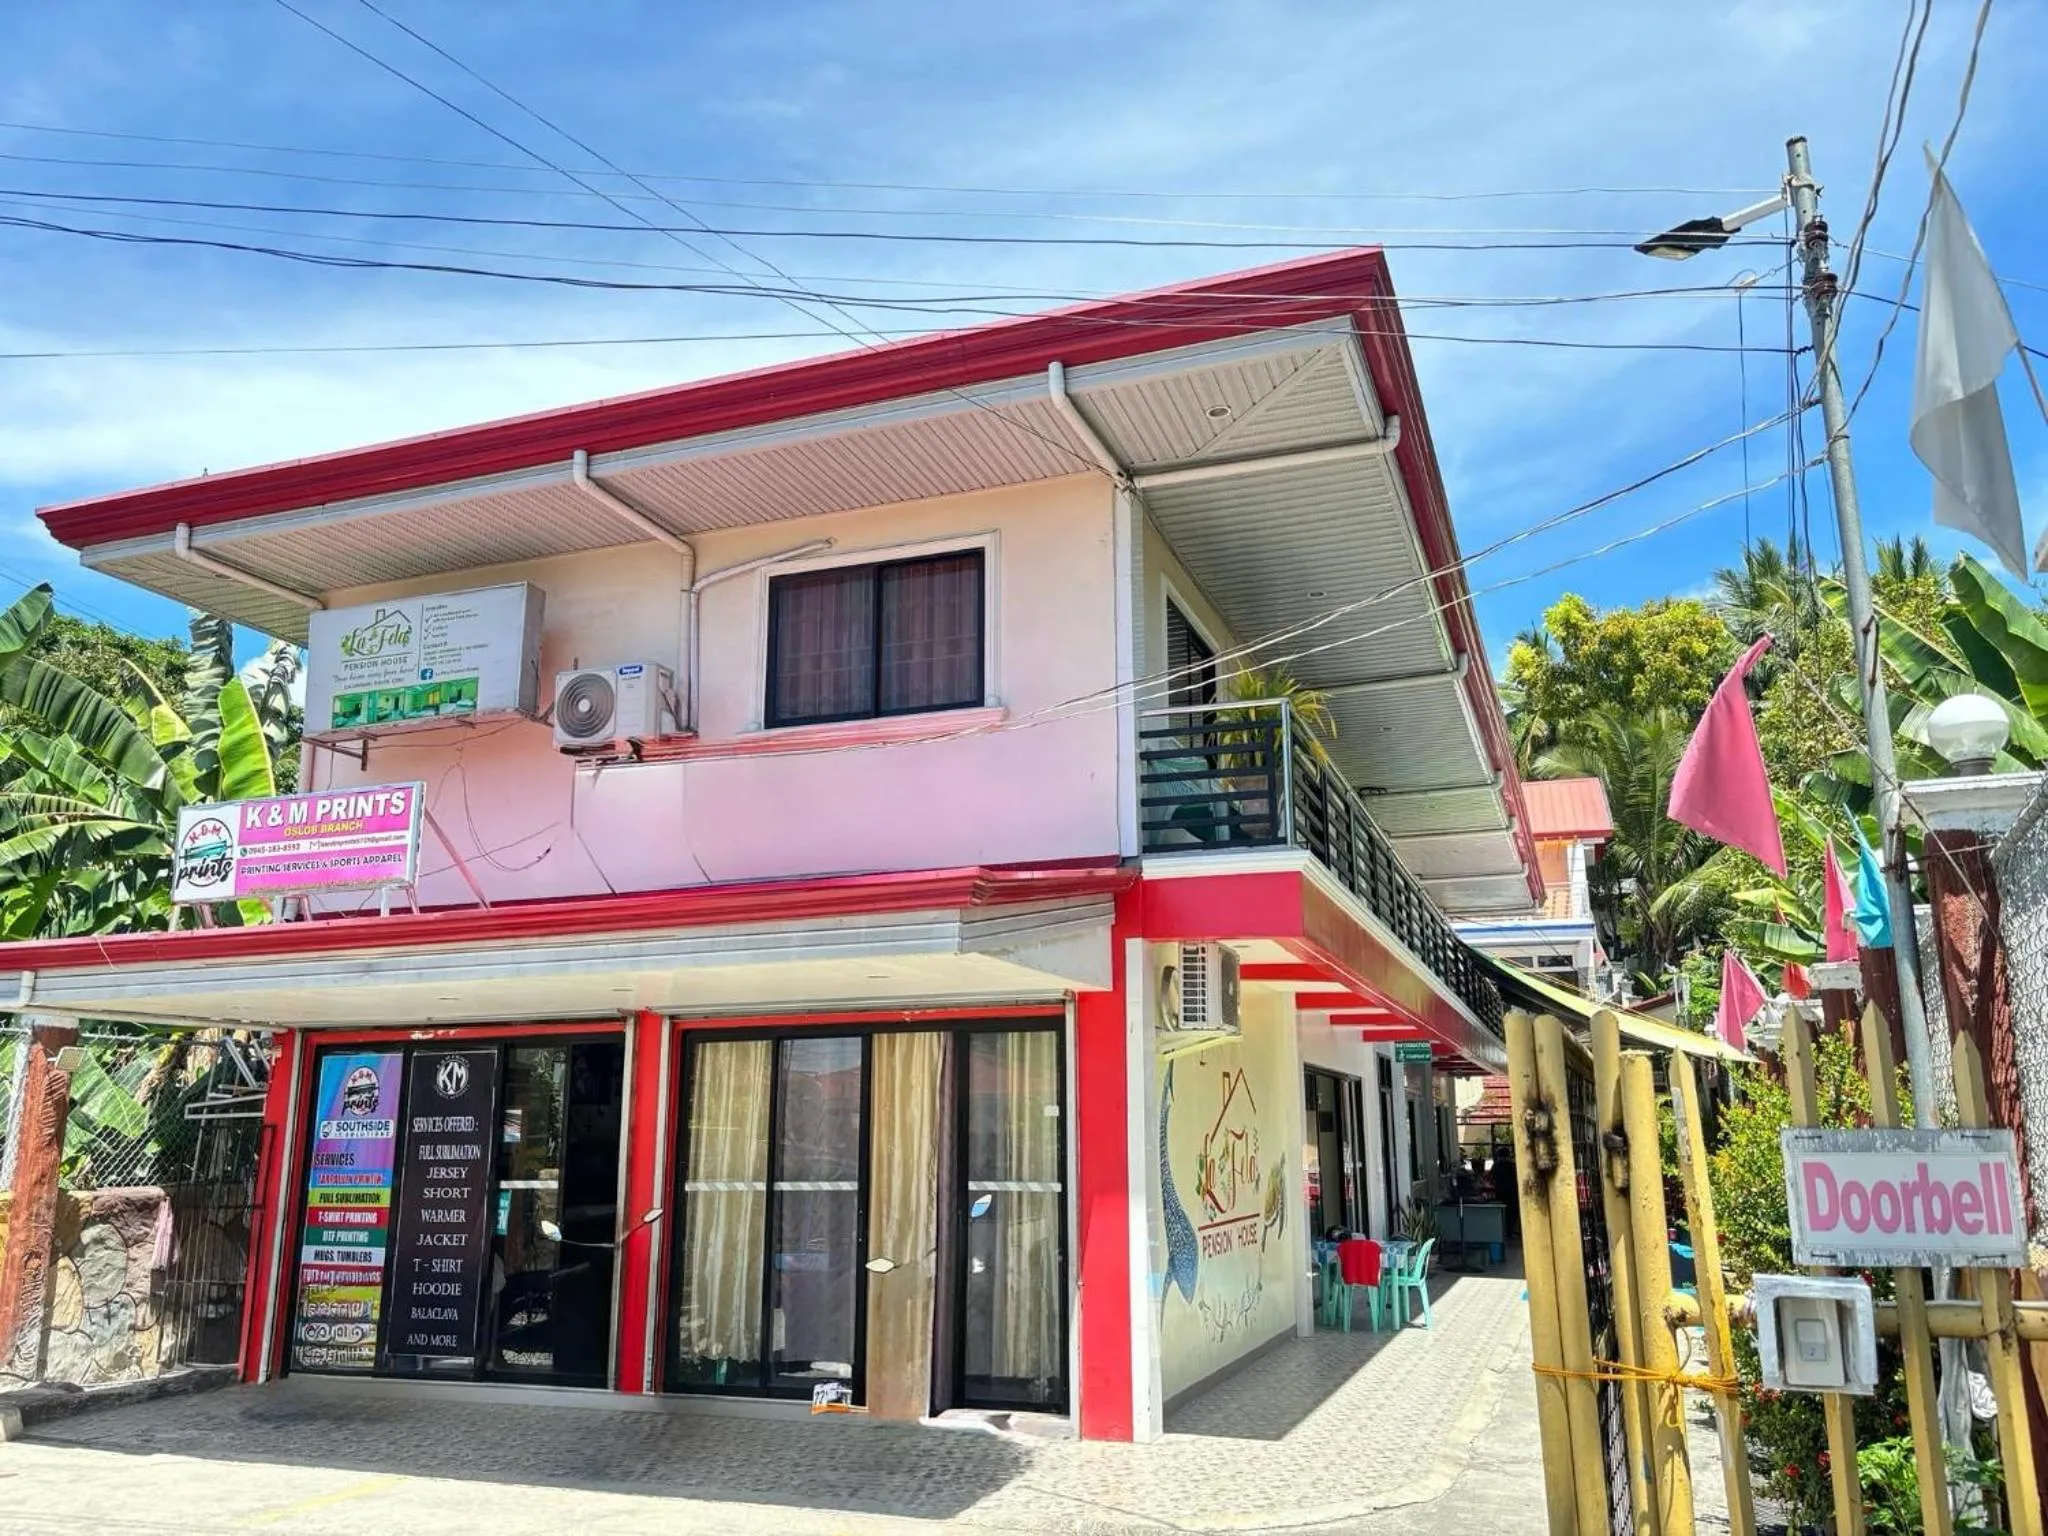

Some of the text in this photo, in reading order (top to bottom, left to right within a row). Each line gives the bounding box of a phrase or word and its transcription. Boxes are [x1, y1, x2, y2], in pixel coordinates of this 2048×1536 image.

[344, 655, 408, 672] PENSION HOUSE
[246, 791, 406, 830] K & M PRINTS
[284, 820, 364, 837] OSLOB BRANCH
[176, 853, 234, 889] prints
[241, 863, 281, 875] PRINTING
[283, 860, 319, 872] SERVICES
[330, 857, 361, 868] SPORTS
[363, 854, 402, 864] APPAREL
[335, 1121, 390, 1132] SOUTHSIDE
[413, 1116, 443, 1132] SERVICES
[444, 1116, 475, 1132] OFFERED
[315, 1152, 355, 1166] SERVICES
[419, 1144, 481, 1160] FULL SUBLIMATION
[427, 1166, 468, 1179] JERSEY
[319, 1191, 381, 1204] FULL SUBLIMATION
[423, 1187, 472, 1198] SHORT
[1803, 1161, 2014, 1236] Doorbell
[318, 1211, 378, 1224] T-SHIRT PRINTING
[421, 1208, 466, 1223] WARMER
[336, 1230, 369, 1243] PRINTING
[416, 1233, 468, 1246] JACKET
[1202, 1222, 1258, 1259] PENSION HOUSE
[337, 1250, 372, 1263] TUMBLERS
[413, 1258, 421, 1272] T
[431, 1258, 463, 1273] SHIRT
[412, 1282, 462, 1296] HOODIE
[410, 1306, 458, 1321] BALACLAVA
[406, 1333, 457, 1347] AND MORE
